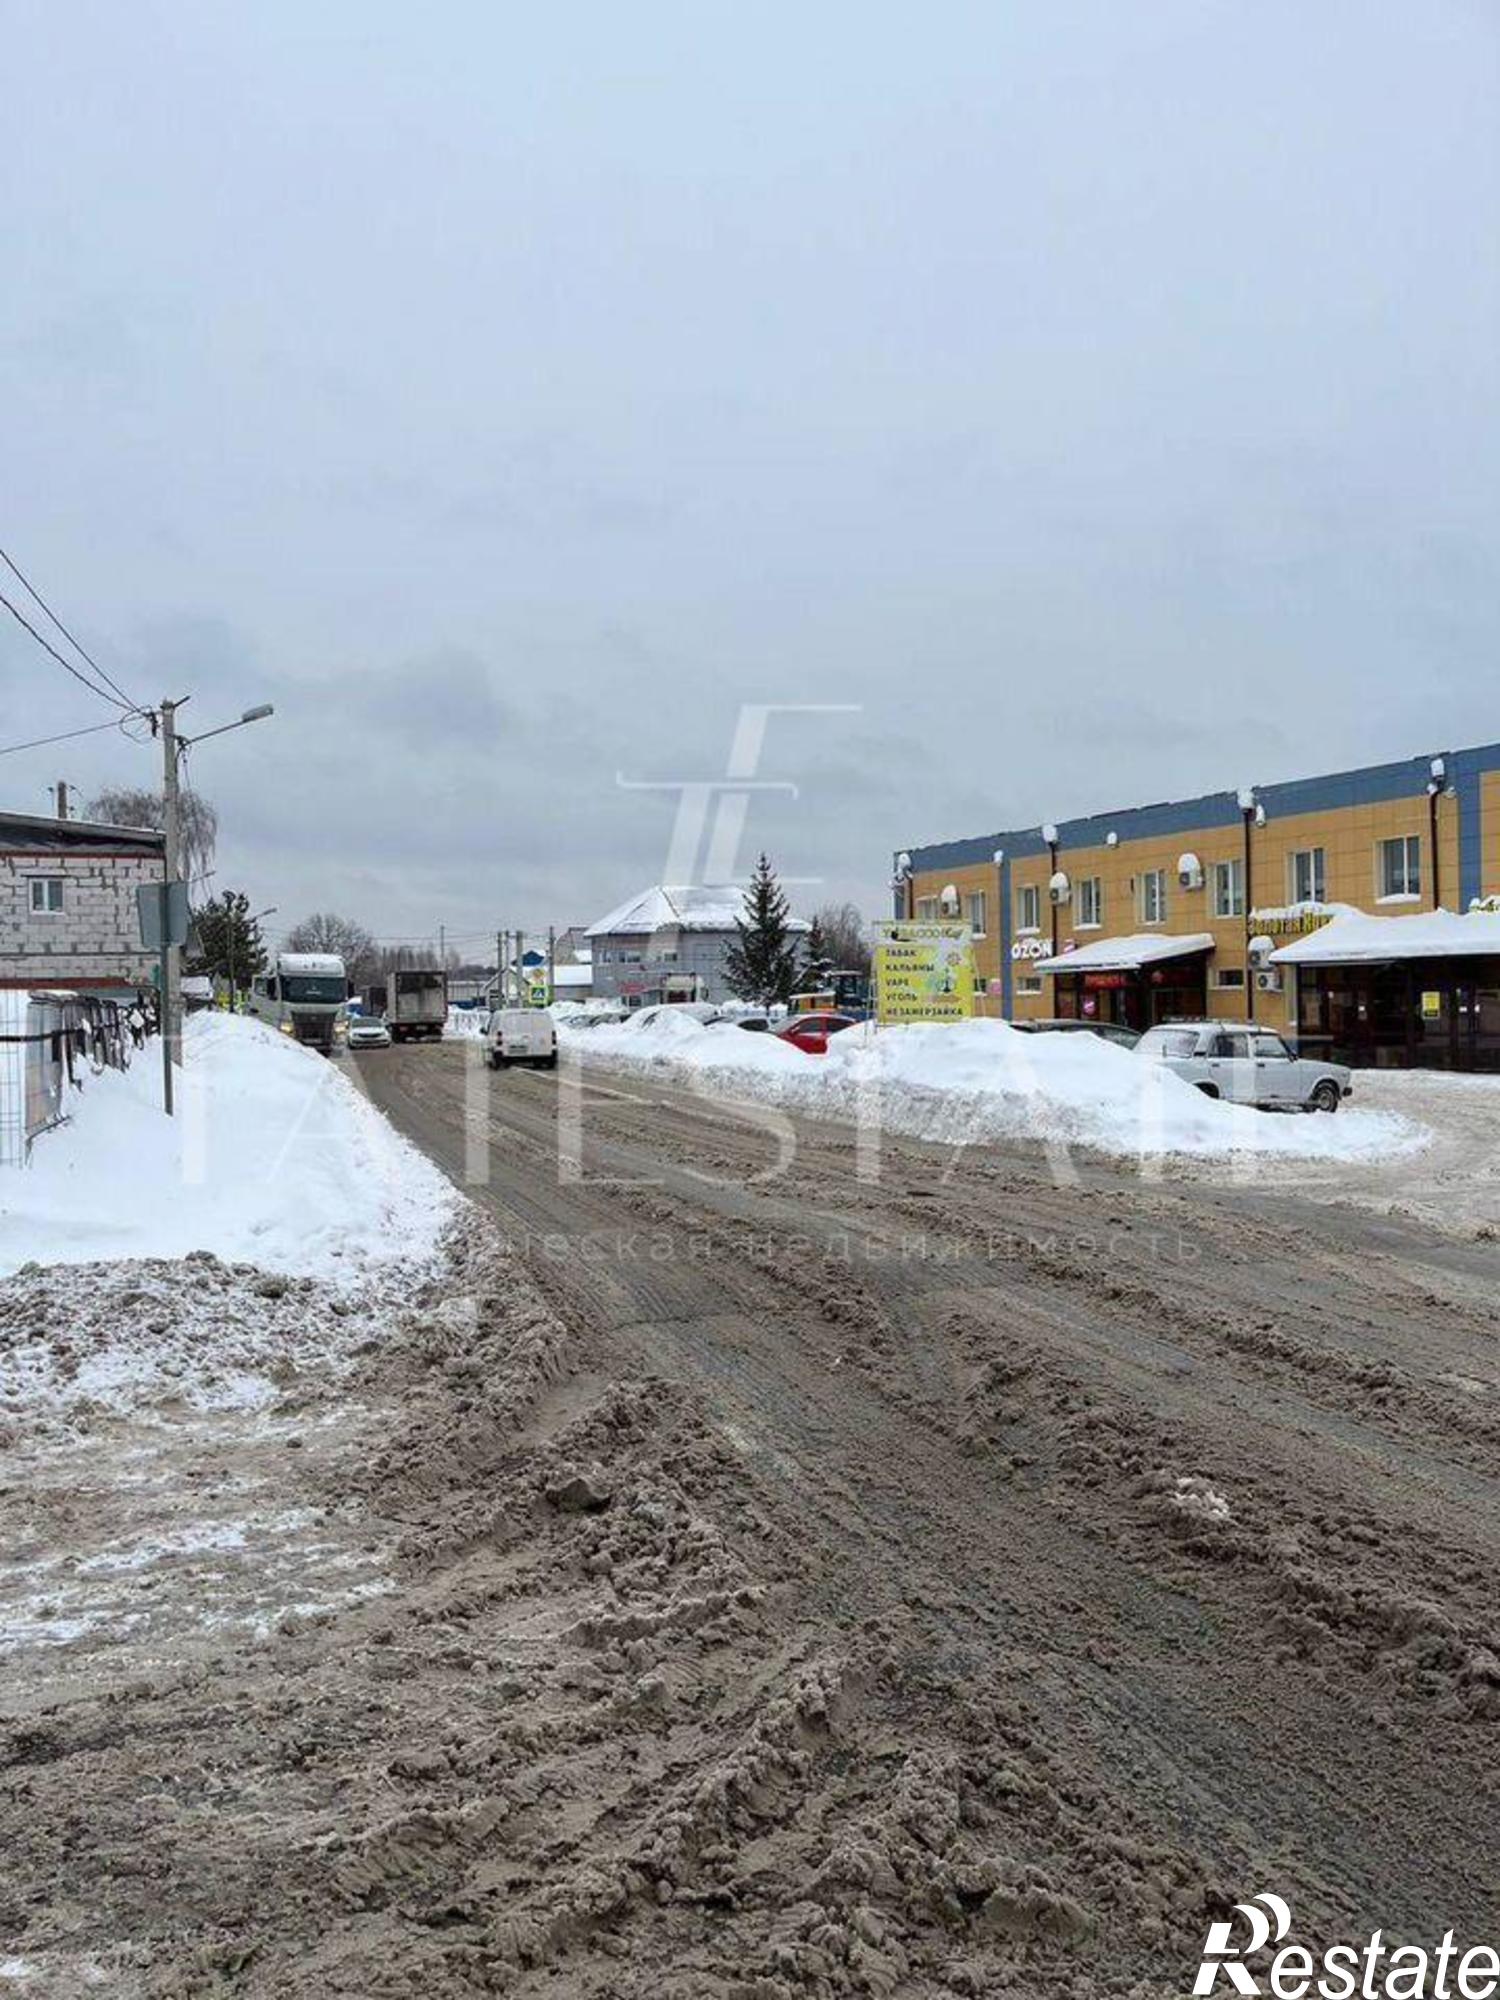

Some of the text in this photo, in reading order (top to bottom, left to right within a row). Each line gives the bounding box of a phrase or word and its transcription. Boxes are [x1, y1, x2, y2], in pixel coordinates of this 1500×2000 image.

[885, 949, 917, 957] ТАБАК
[1011, 942, 1053, 959] OZON
[885, 963, 935, 972] КАЛЬЯНЫ
[885, 978, 909, 987] VAPE
[885, 993, 918, 1001] УГОЛЬ
[885, 1006, 964, 1016] НЕЗАМЕРЗАЙКА
